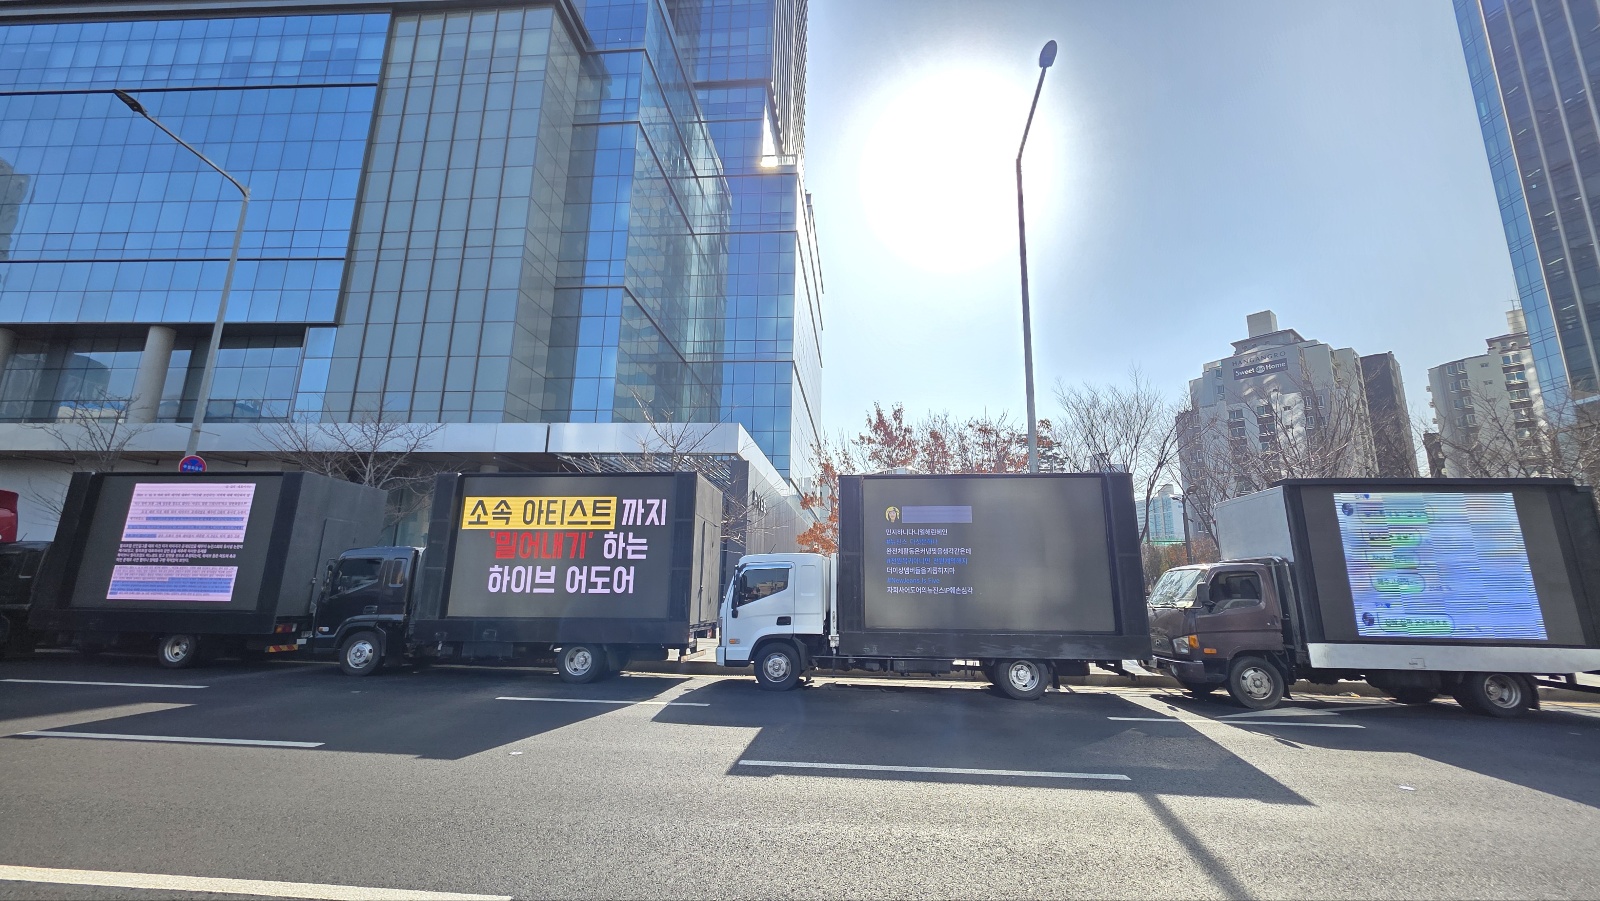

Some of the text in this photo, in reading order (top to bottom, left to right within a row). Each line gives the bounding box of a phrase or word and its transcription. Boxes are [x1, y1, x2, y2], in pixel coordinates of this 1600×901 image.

[1231, 351, 1286, 367] HANGANGRO
[1235, 367, 1255, 376] Sweet
[1265, 362, 1286, 371] Home
[468, 498, 667, 526] 소속 아티스트 까지
[603, 531, 648, 559] 하는
[487, 565, 635, 593] 하이브 어도어
